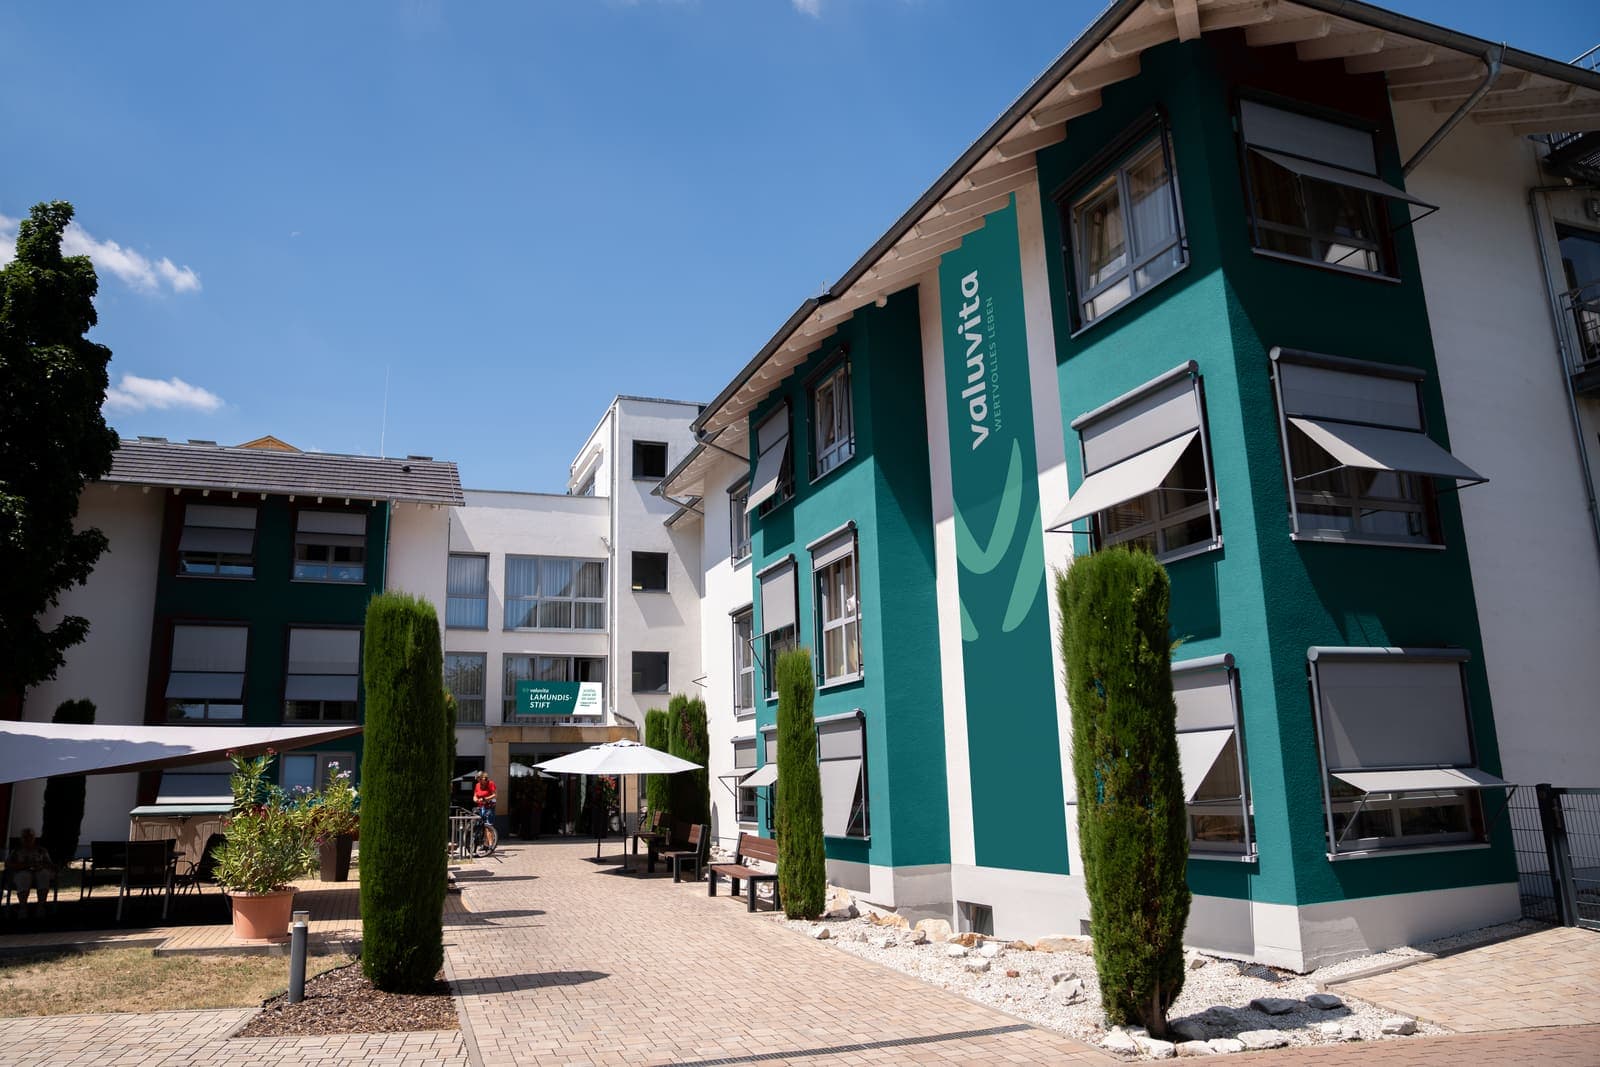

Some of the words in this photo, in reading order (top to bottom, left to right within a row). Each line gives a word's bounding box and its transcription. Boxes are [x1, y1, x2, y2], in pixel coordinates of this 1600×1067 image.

[986, 297, 996, 337] LEBEN
[958, 270, 989, 451] valuvita
[989, 342, 1002, 432] WERTVOLLES
[530, 701, 551, 709] STIFT
